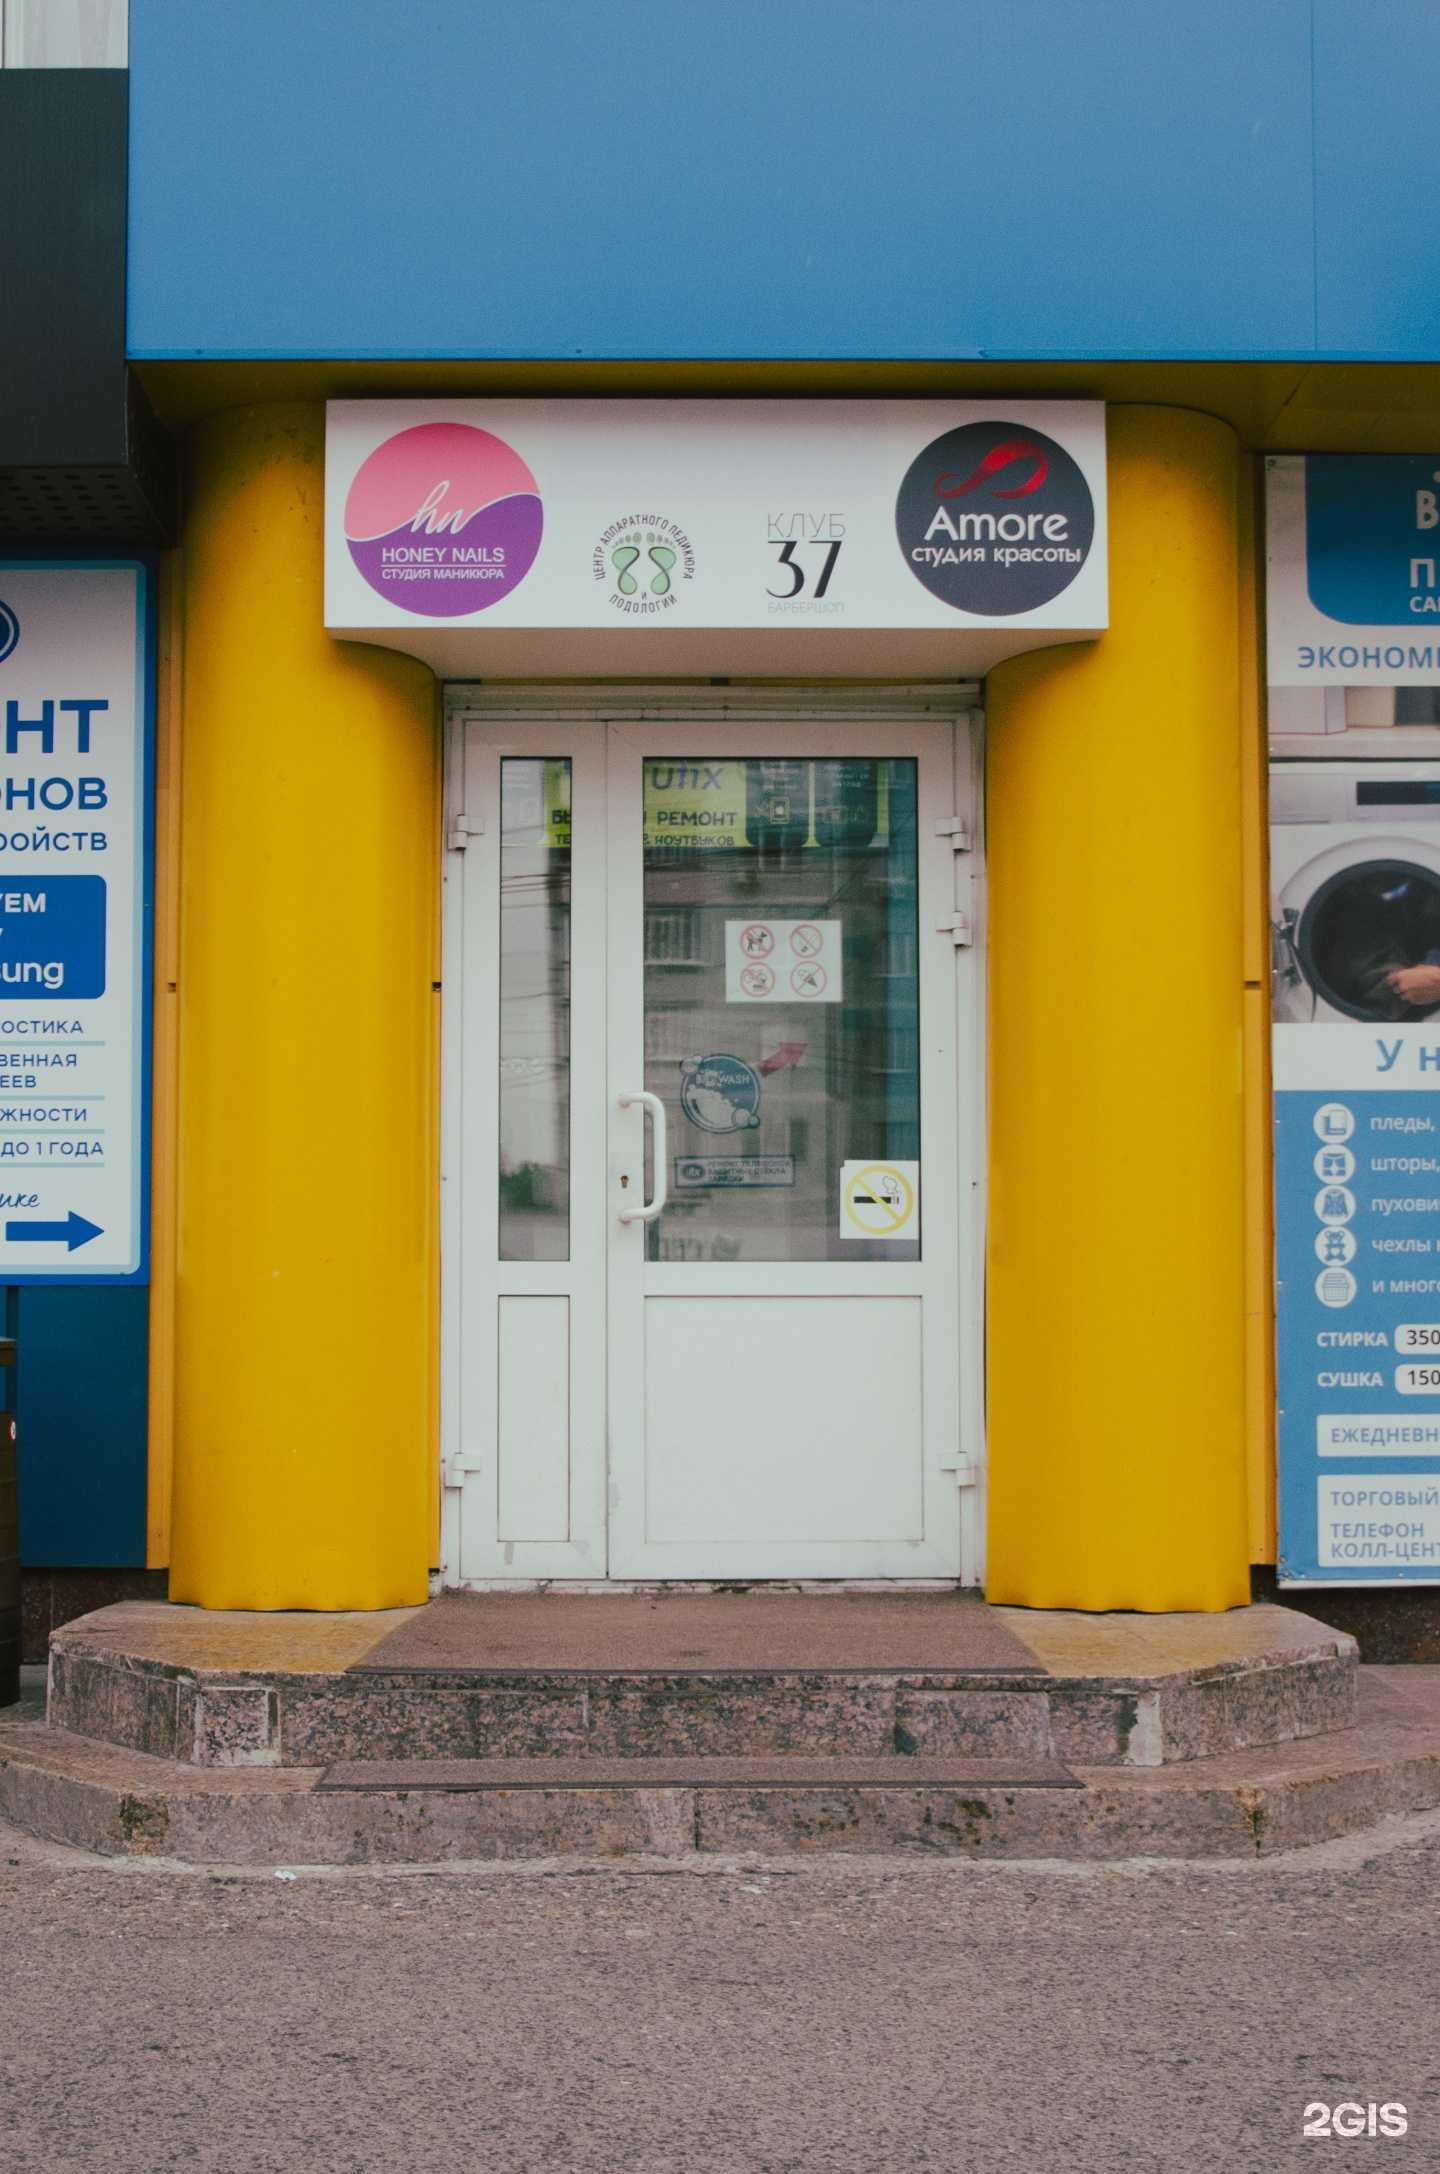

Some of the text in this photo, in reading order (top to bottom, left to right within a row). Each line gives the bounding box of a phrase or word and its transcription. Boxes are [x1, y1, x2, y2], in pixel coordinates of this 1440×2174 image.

[767, 512, 846, 538] КЛУБ
[924, 506, 1069, 542] Amore
[382, 547, 505, 563] HONEY NAILS
[592, 514, 696, 580] ЦЕНТР АППАРАТНОГО ПЕДИКЮРА
[911, 546, 1081, 567] студия красоты
[381, 568, 505, 580] СТУДИЯ МАНИКЮРА
[765, 540, 843, 599] 37
[609, 593, 678, 614] ПОДОЛОГИИ
[767, 602, 845, 614] БАРБЕРШОП
[1410, 596, 1440, 613] СА
[0, 700, 108, 753] НТ
[0, 777, 108, 811] НОВ
[656, 811, 737, 826] РЕМОНТ
[0, 892, 46, 913] ЕМ
[0, 962, 64, 989] ung
[1, 1020, 84, 1034] ОСТИКА
[1375, 1038, 1405, 1072] У
[0, 1108, 87, 1122] ЖНОСТИ
[1370, 1116, 1436, 1134] пледы,
[1, 1141, 104, 1157] ДО 1 ГОДА
[1371, 1157, 1440, 1176] шторы,
[1371, 1239, 1432, 1253] чехлы
[1371, 1280, 1385, 1294] и
[1316, 1329, 1440, 1348] СТИРКА 350
[1317, 1369, 1440, 1388] СУШКА 150
[1329, 1486, 1439, 1507] ТОРГОВЫЙ
[1329, 1522, 1425, 1538] ТЕЛЕФОН
